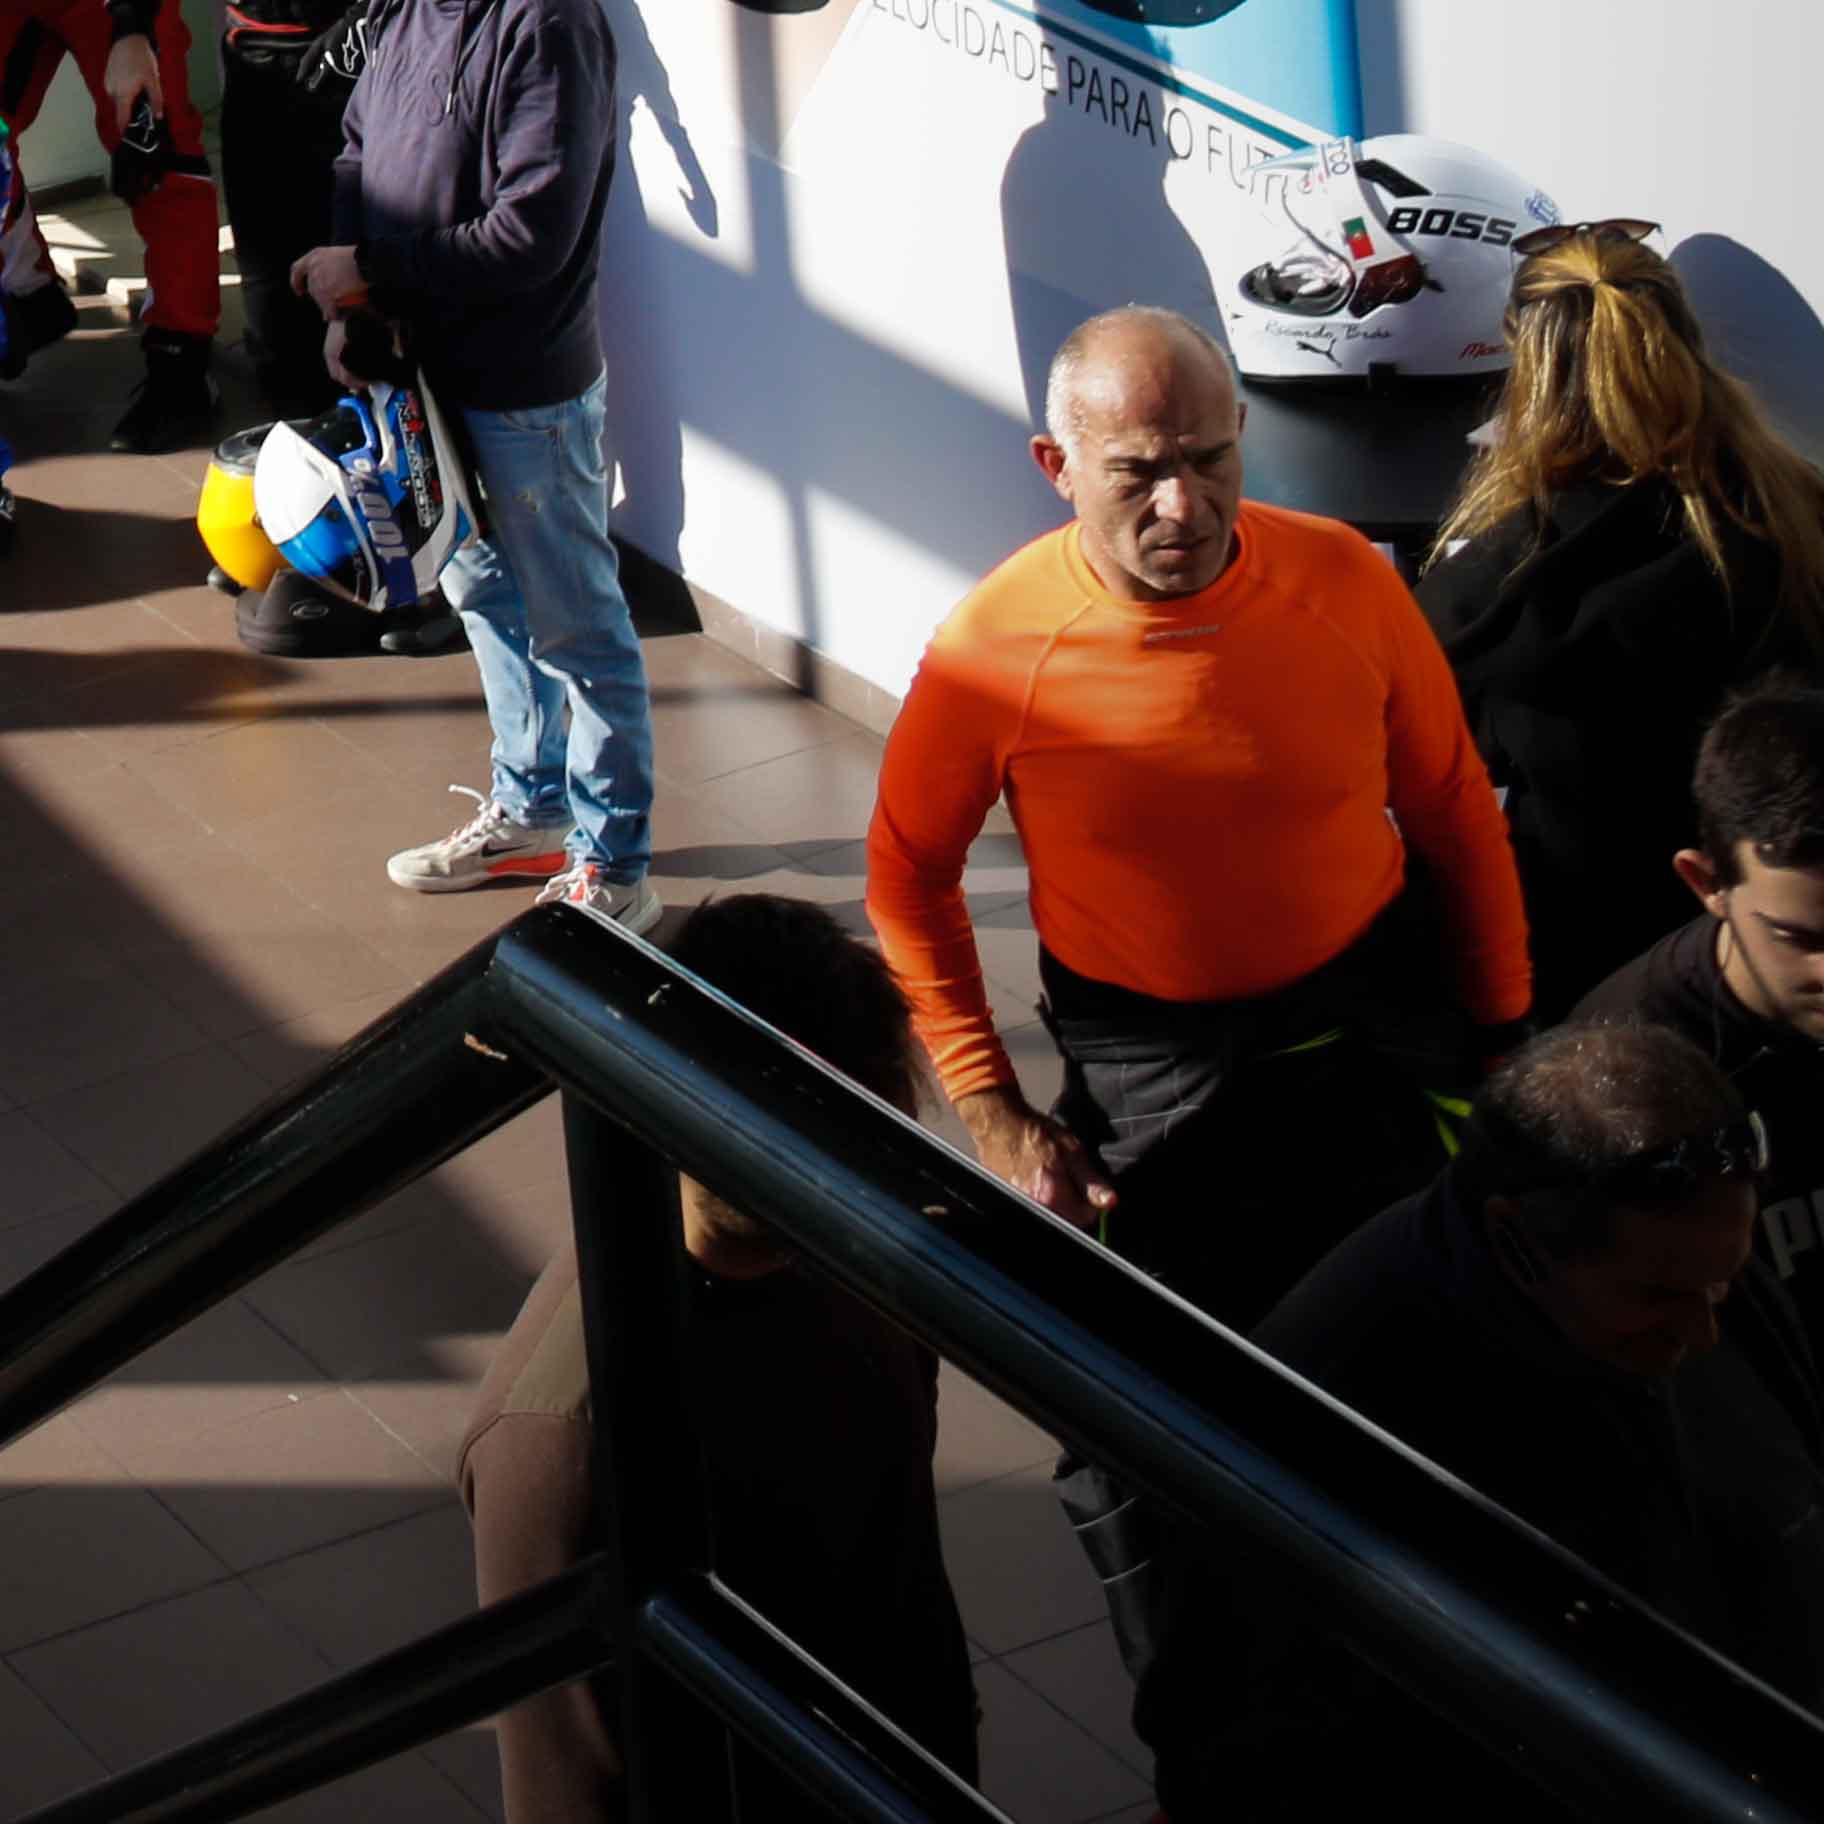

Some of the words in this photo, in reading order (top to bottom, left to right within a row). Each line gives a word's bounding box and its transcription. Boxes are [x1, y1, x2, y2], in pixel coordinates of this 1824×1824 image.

[1067, 56, 1157, 146] PARA
[1166, 107, 1194, 160] O
[1387, 206, 1517, 246] BOSS
